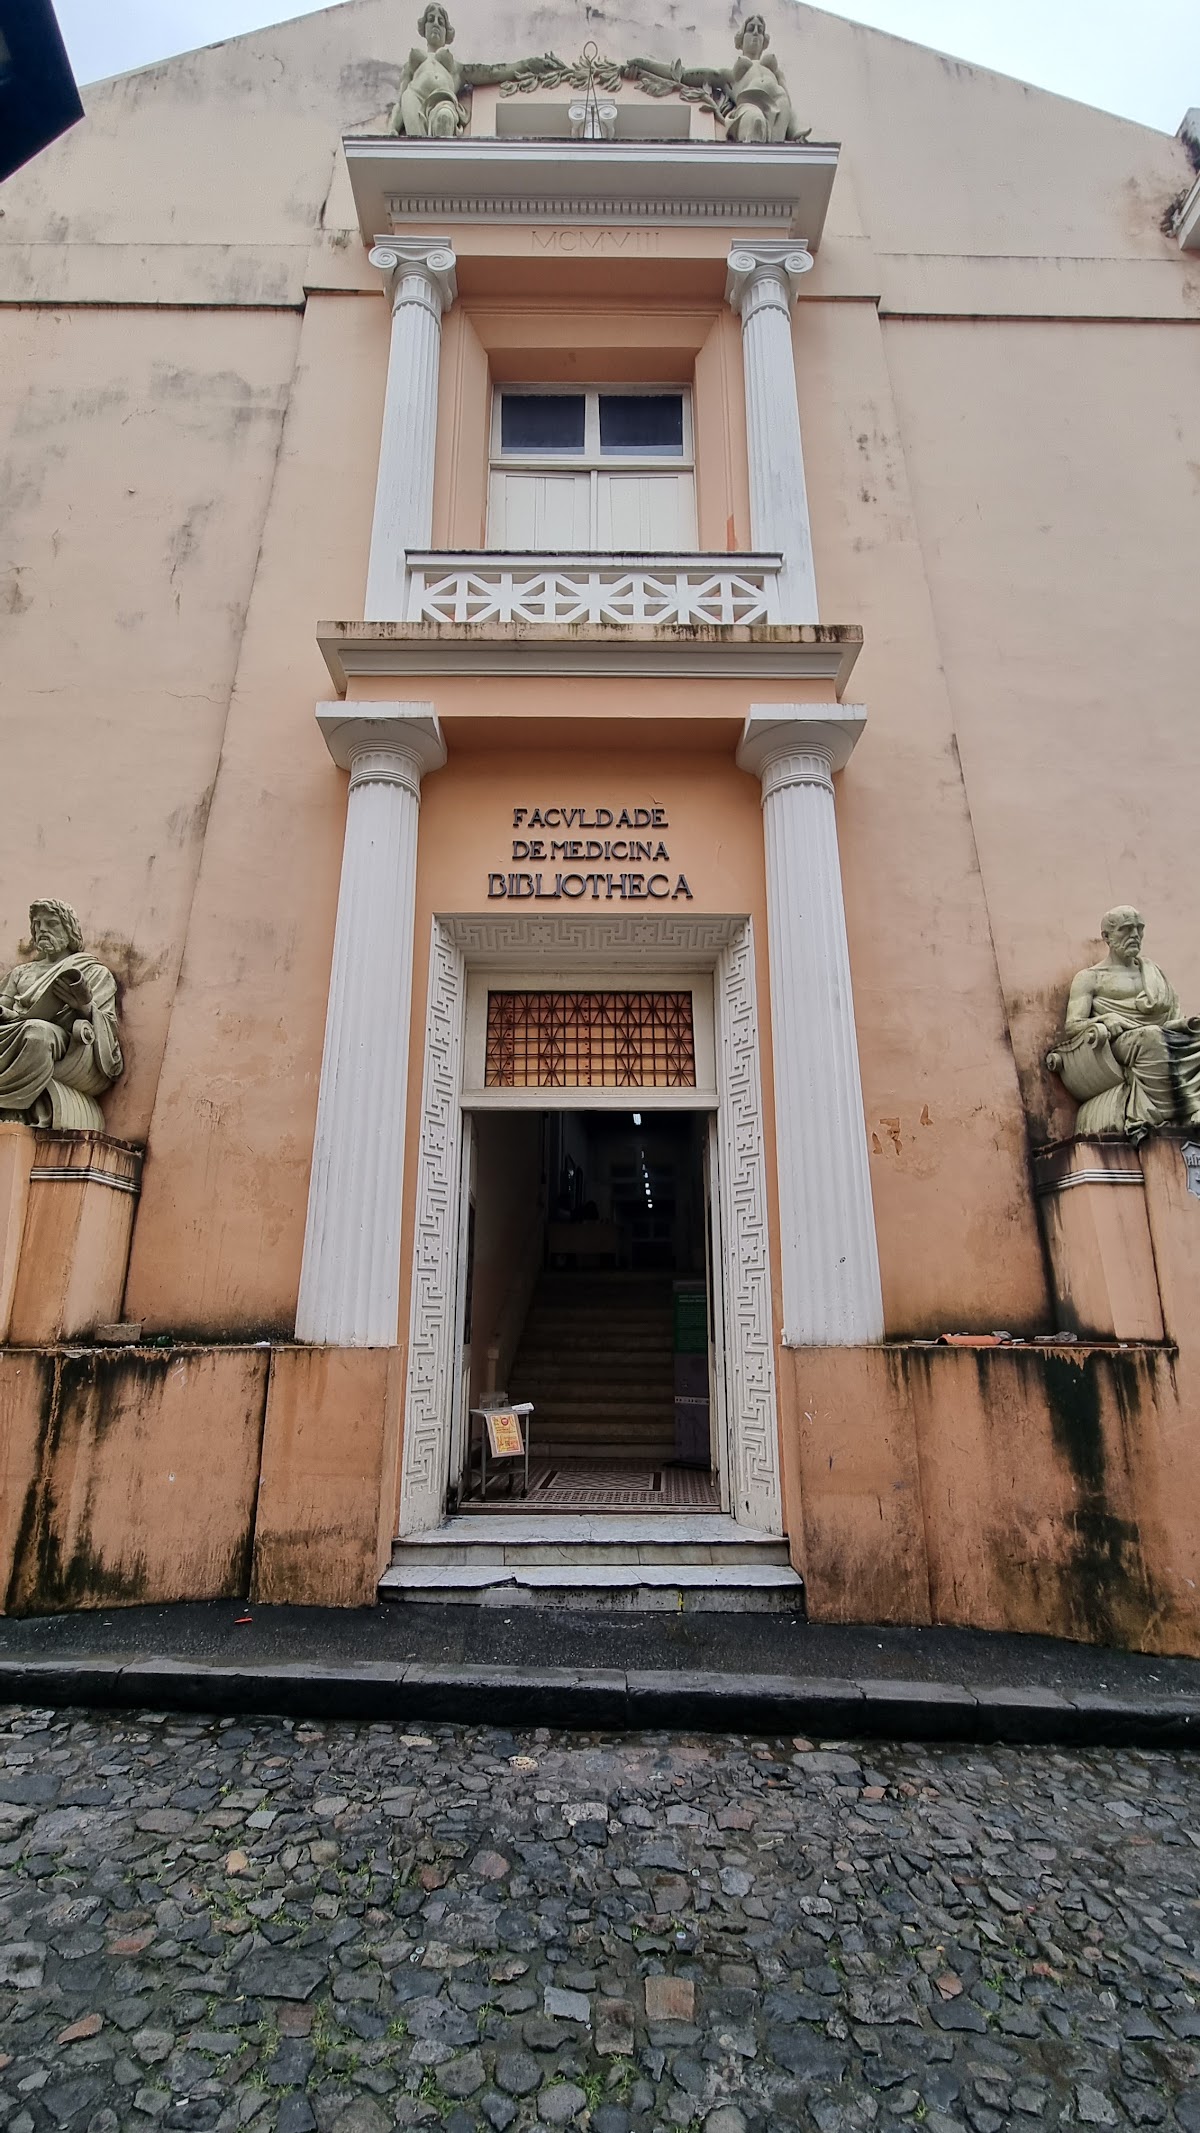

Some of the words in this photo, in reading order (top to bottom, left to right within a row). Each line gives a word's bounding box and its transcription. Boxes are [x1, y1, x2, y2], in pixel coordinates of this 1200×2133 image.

[531, 231, 660, 252] MCMVIII
[513, 808, 669, 828] FACVLDADE
[512, 840, 548, 861] DE
[550, 840, 670, 861] MEDICINA
[487, 872, 694, 899] BIBLIOTHECA
